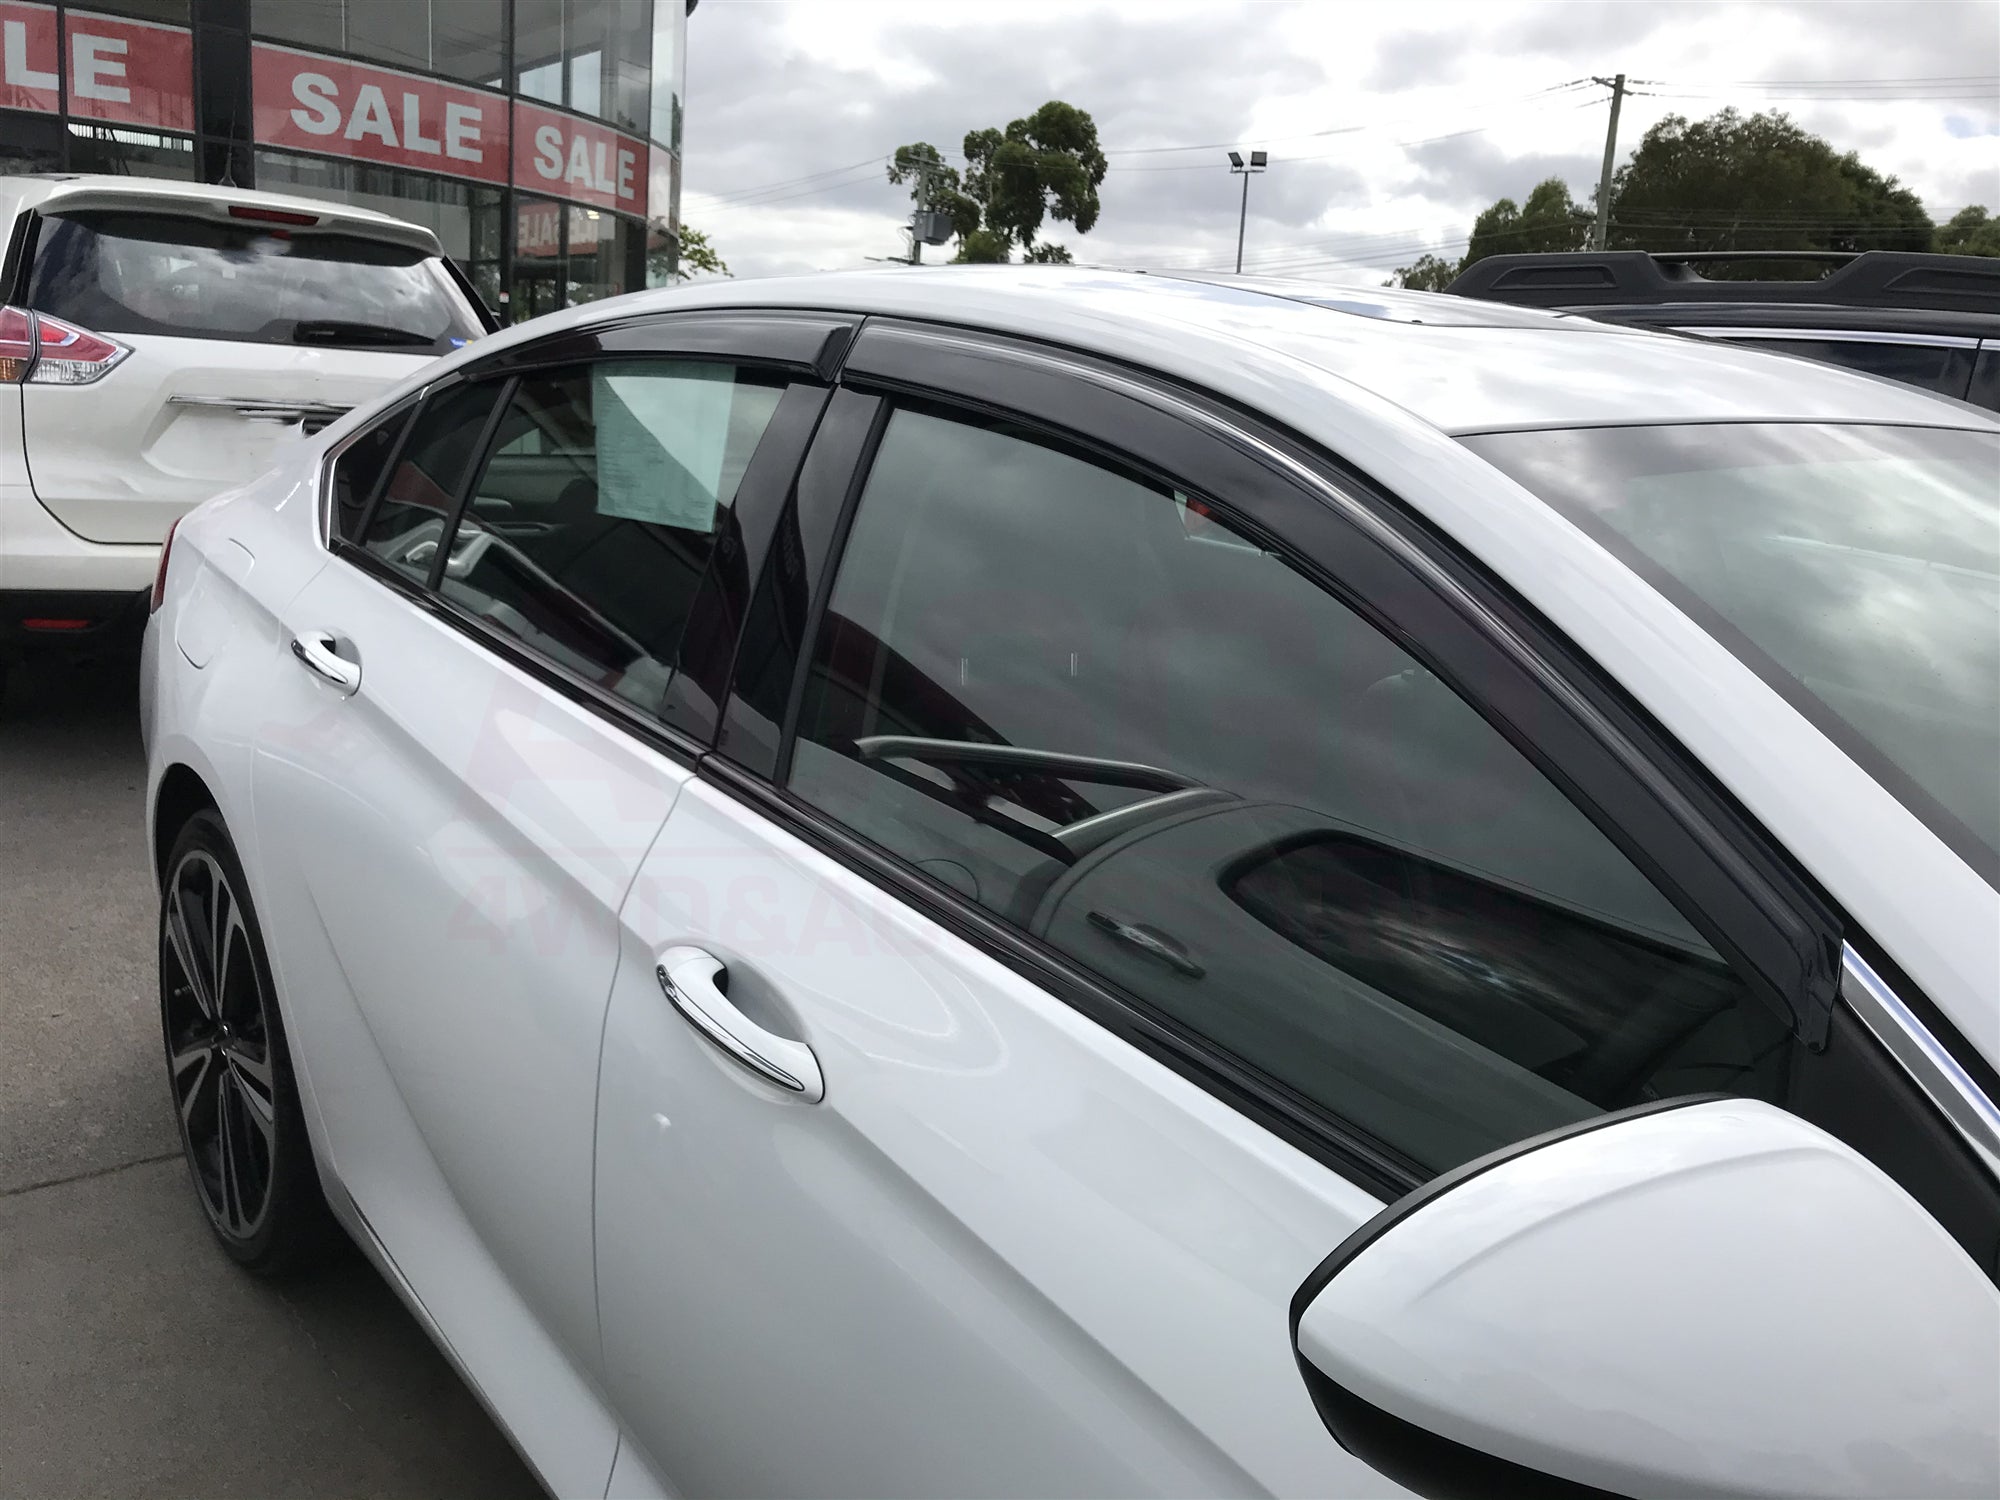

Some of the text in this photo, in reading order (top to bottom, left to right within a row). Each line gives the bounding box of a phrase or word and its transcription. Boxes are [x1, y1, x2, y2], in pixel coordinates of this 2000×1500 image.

[4, 20, 131, 104] LE
[290, 72, 483, 163] SALE
[533, 125, 635, 200] SALE
